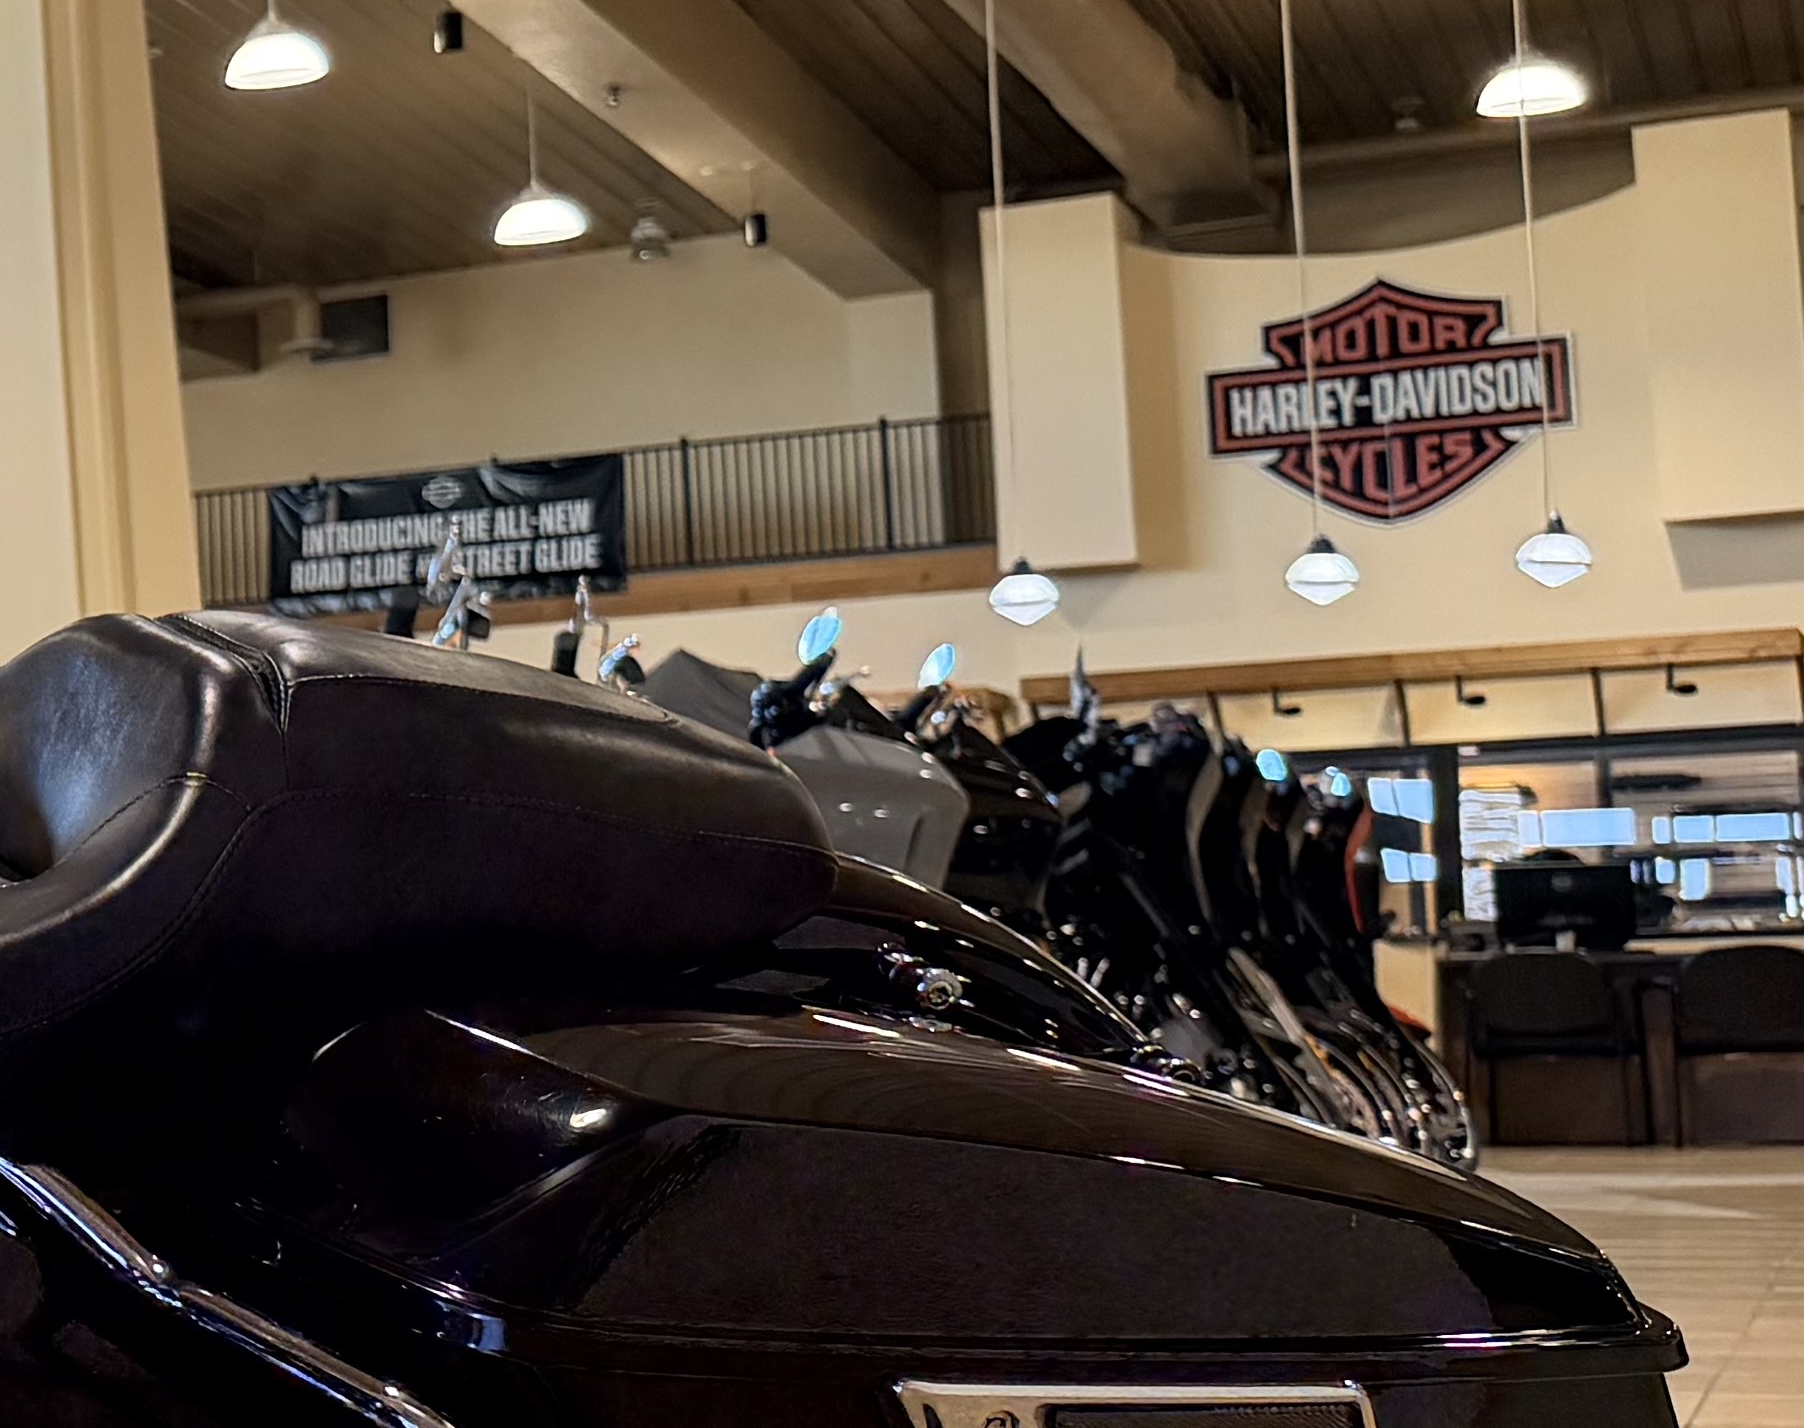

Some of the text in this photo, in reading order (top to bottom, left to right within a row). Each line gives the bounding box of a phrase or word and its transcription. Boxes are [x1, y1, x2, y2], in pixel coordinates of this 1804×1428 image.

[1300, 301, 1471, 363] MOTOR
[1228, 357, 1544, 437] HARLEY-DAVIDSON
[1306, 430, 1474, 502] CYCLES
[301, 498, 592, 558] INTRODUCING HE ALL-NEW
[534, 533, 602, 573] GLIDE
[290, 556, 347, 595] ROAD
[349, 550, 413, 589] GLIDE
